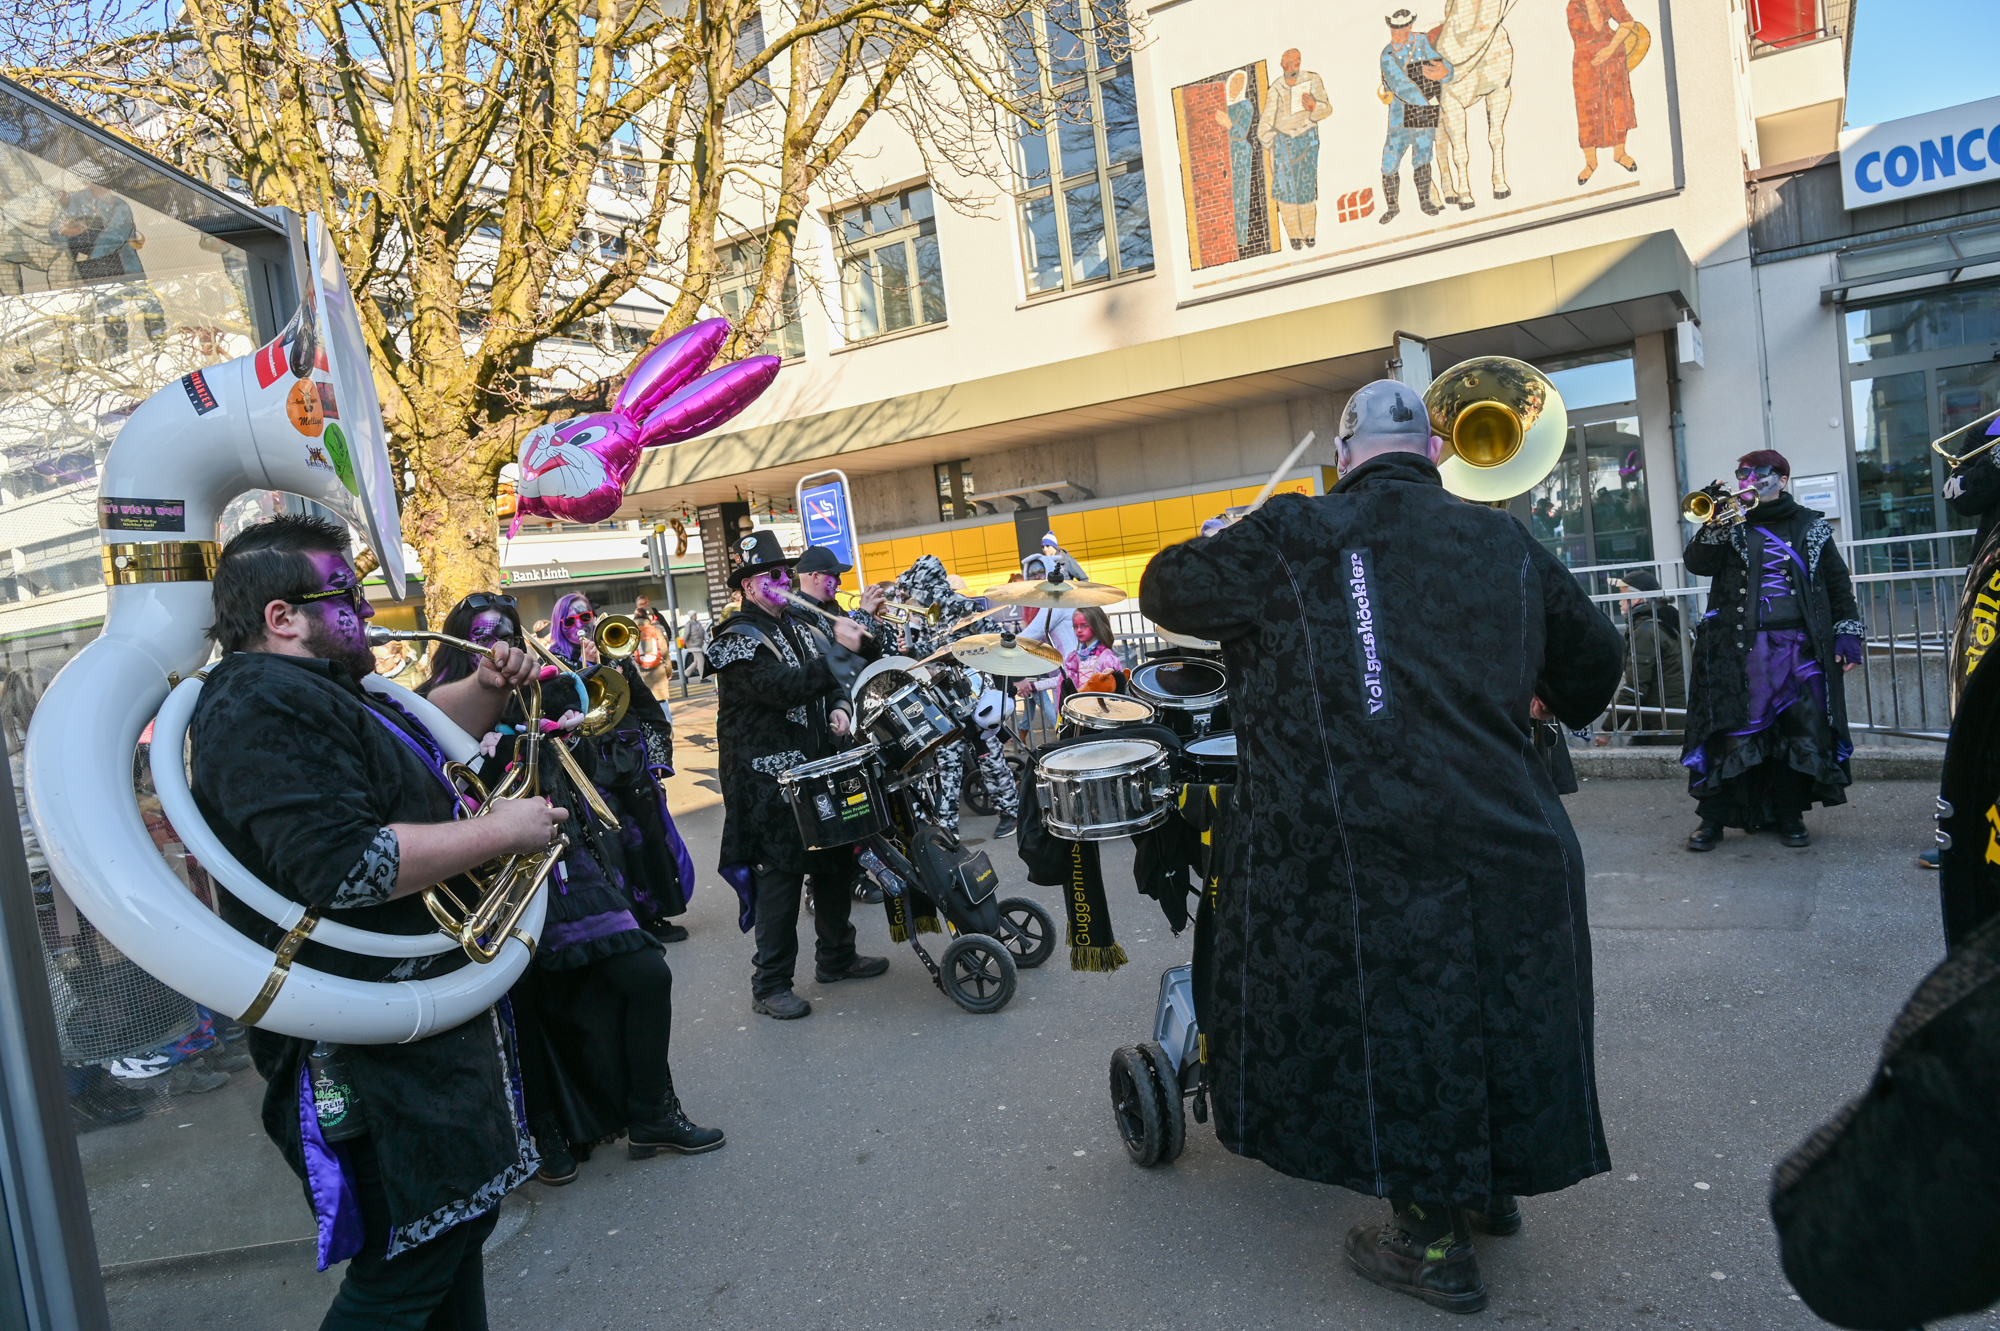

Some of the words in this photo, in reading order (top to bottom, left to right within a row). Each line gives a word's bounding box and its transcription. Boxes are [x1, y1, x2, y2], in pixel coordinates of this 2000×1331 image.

[1804, 493, 1831, 501] CONCORDIA
[120, 504, 152, 515] wie's
[865, 550, 890, 558] Empfangen
[512, 569, 541, 582] Bank
[540, 566, 569, 580] Linth
[1008, 604, 1018, 617] 2
